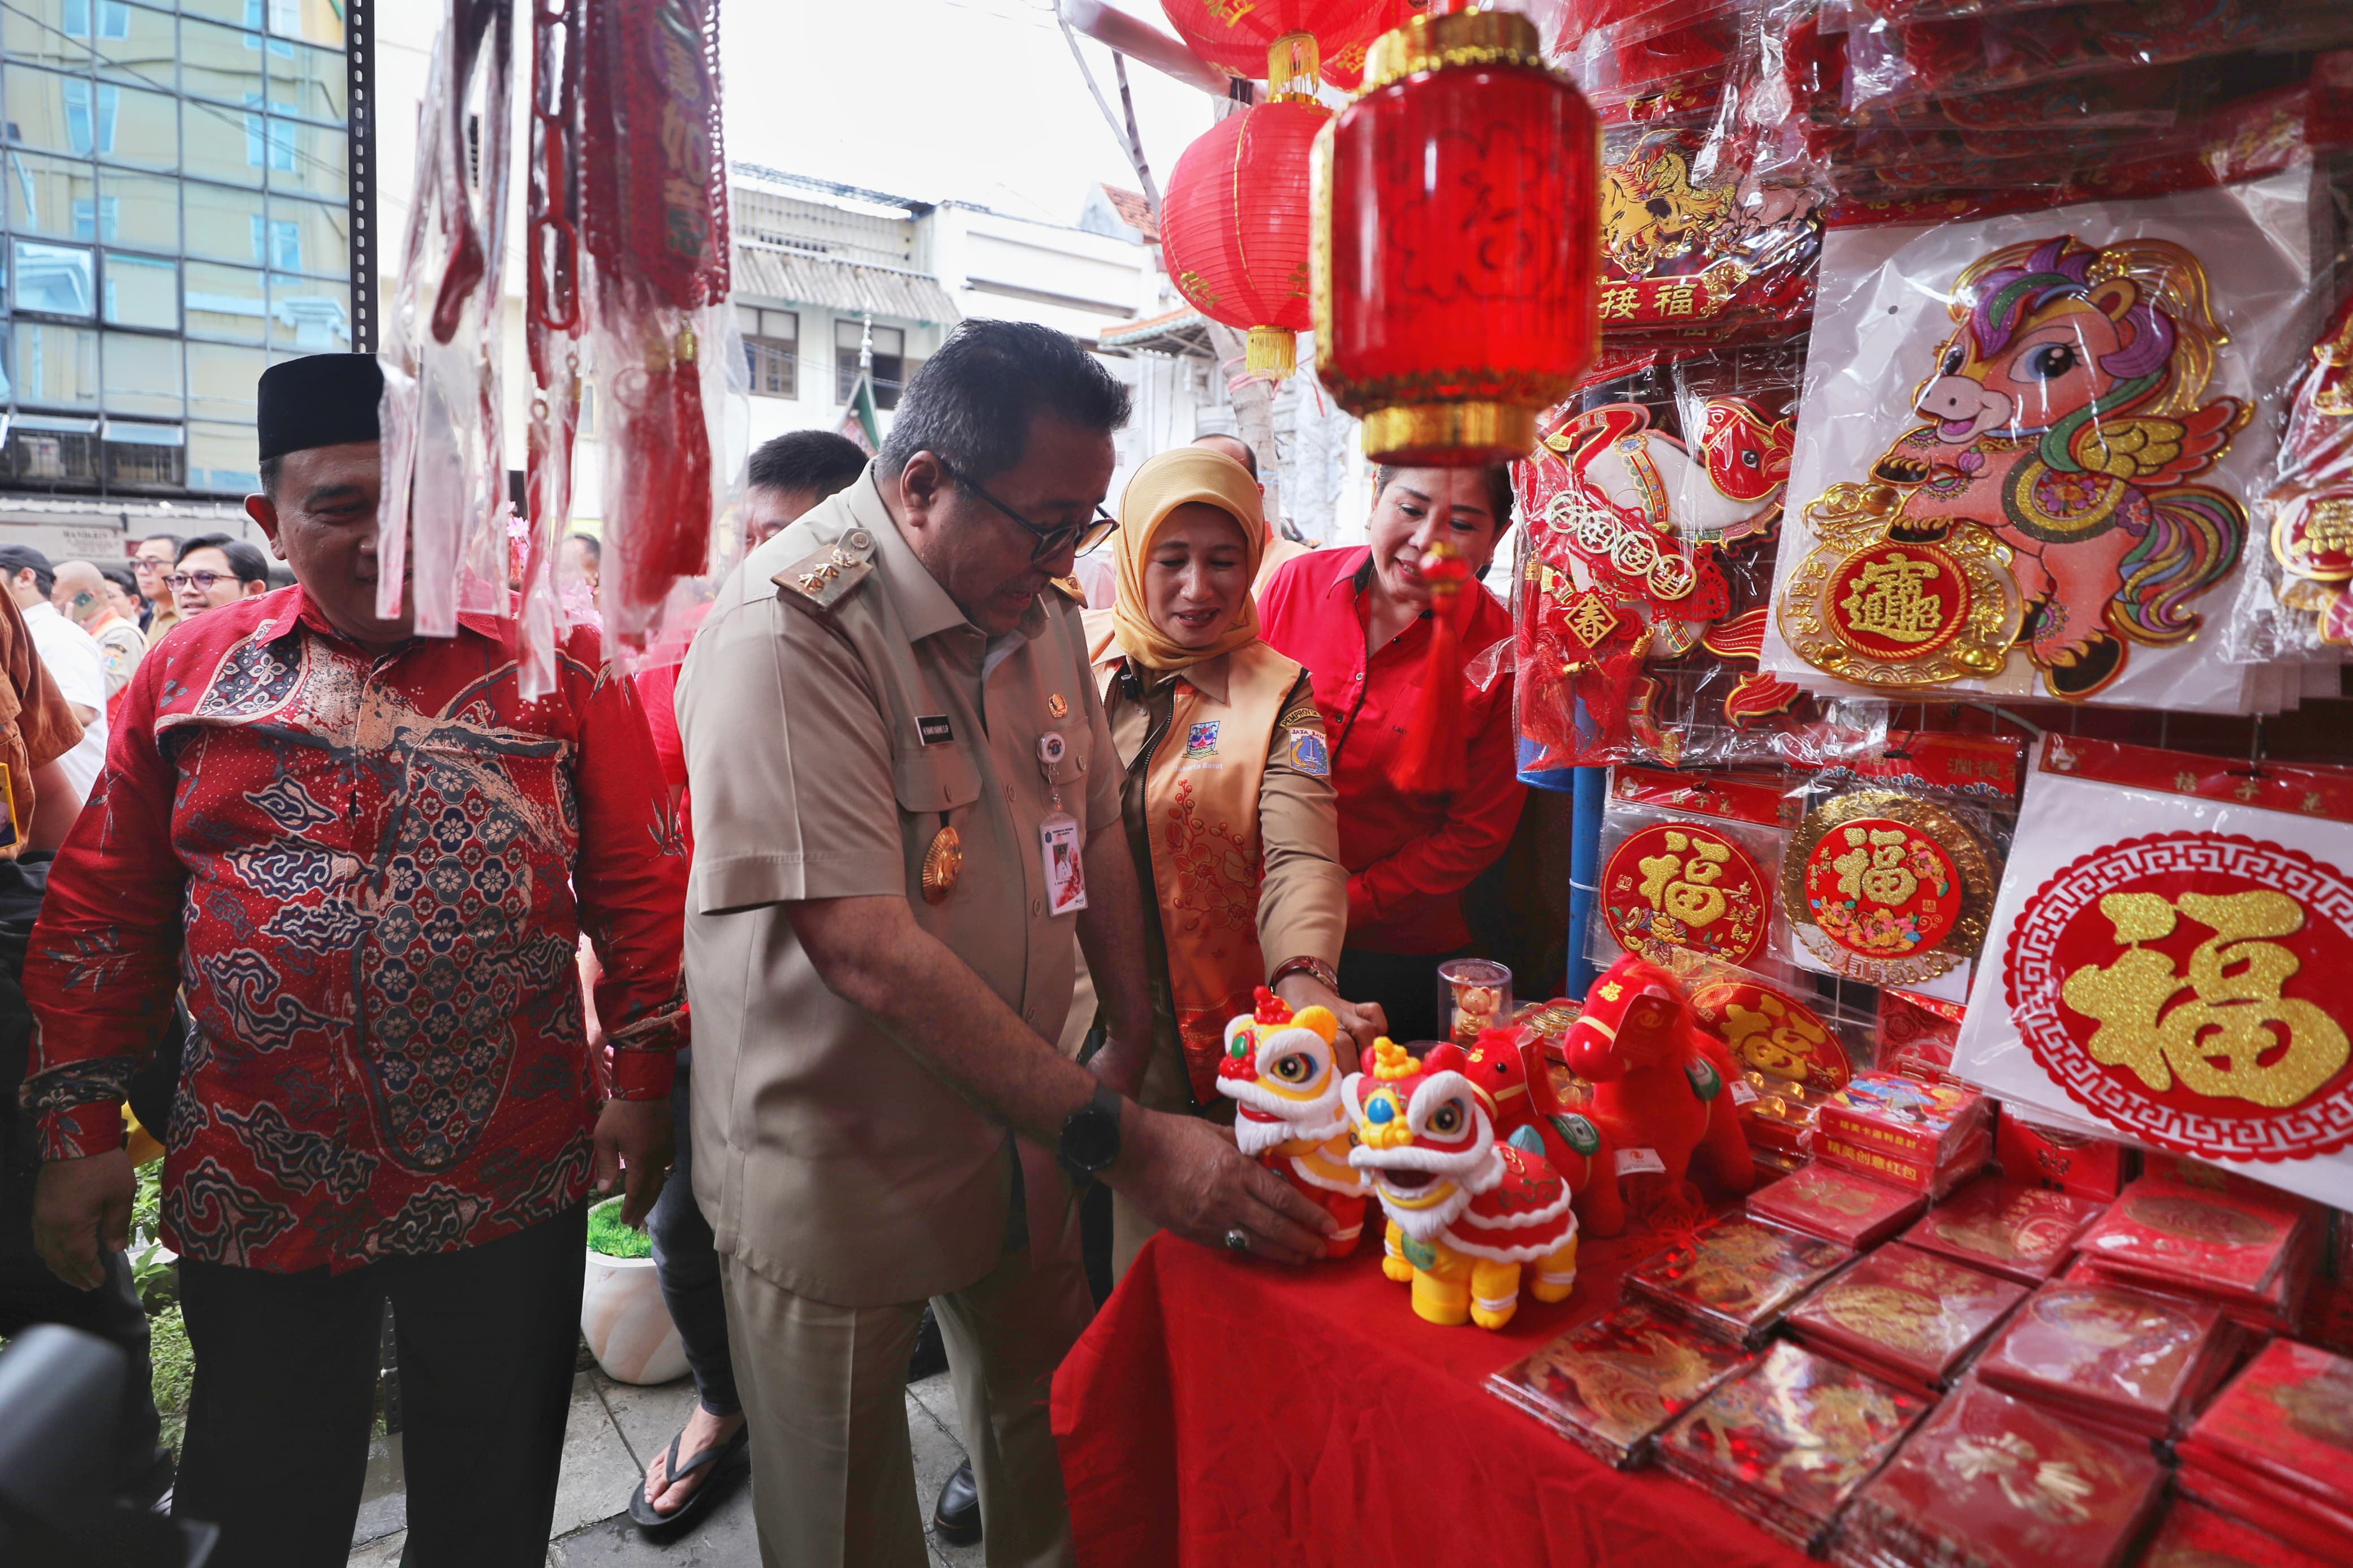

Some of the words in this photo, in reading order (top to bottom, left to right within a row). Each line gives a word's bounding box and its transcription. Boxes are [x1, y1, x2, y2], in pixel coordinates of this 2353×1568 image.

[1598, 283, 1699, 319] 接福
[1574, 599, 1606, 640] 春
[1282, 709, 1311, 725] PEMPROV
[1638, 831, 1731, 928] 福
[1833, 827, 1918, 906] 福
[1597, 980, 1624, 1002] 福
[2062, 889, 2350, 1108] 福
[1720, 994, 1827, 1081] 福
[1828, 1140, 1917, 1181] 精美创意红包
